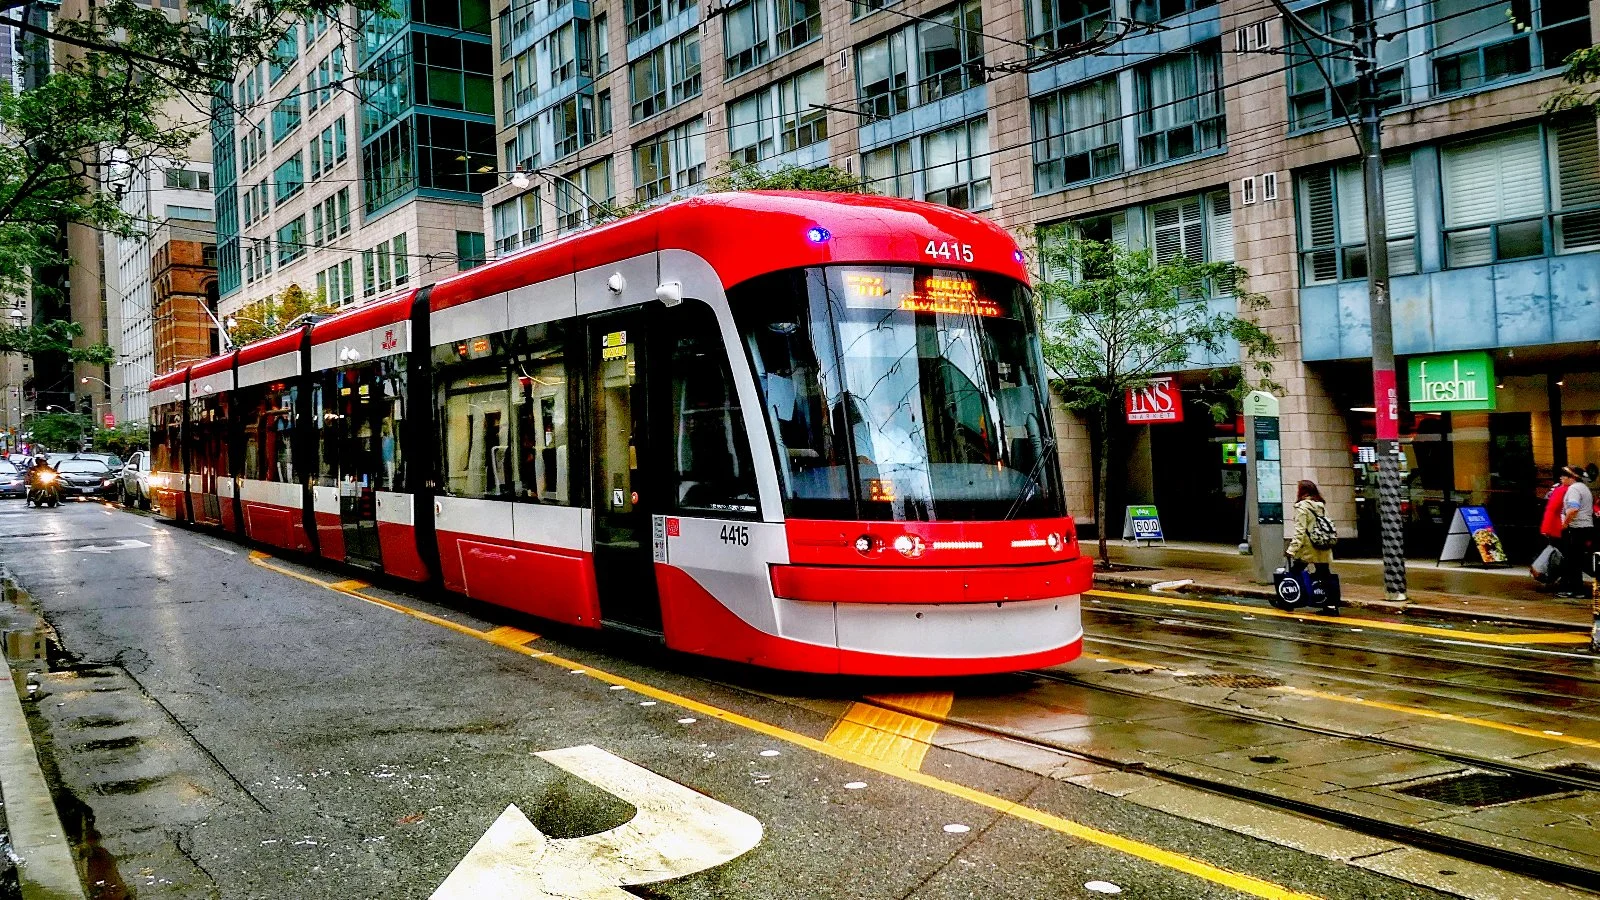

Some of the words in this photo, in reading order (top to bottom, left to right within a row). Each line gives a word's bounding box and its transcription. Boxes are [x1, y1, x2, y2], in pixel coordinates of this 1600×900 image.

[925, 240, 974, 263] 4415
[1419, 359, 1476, 401] freshii
[720, 524, 749, 547] 4415
